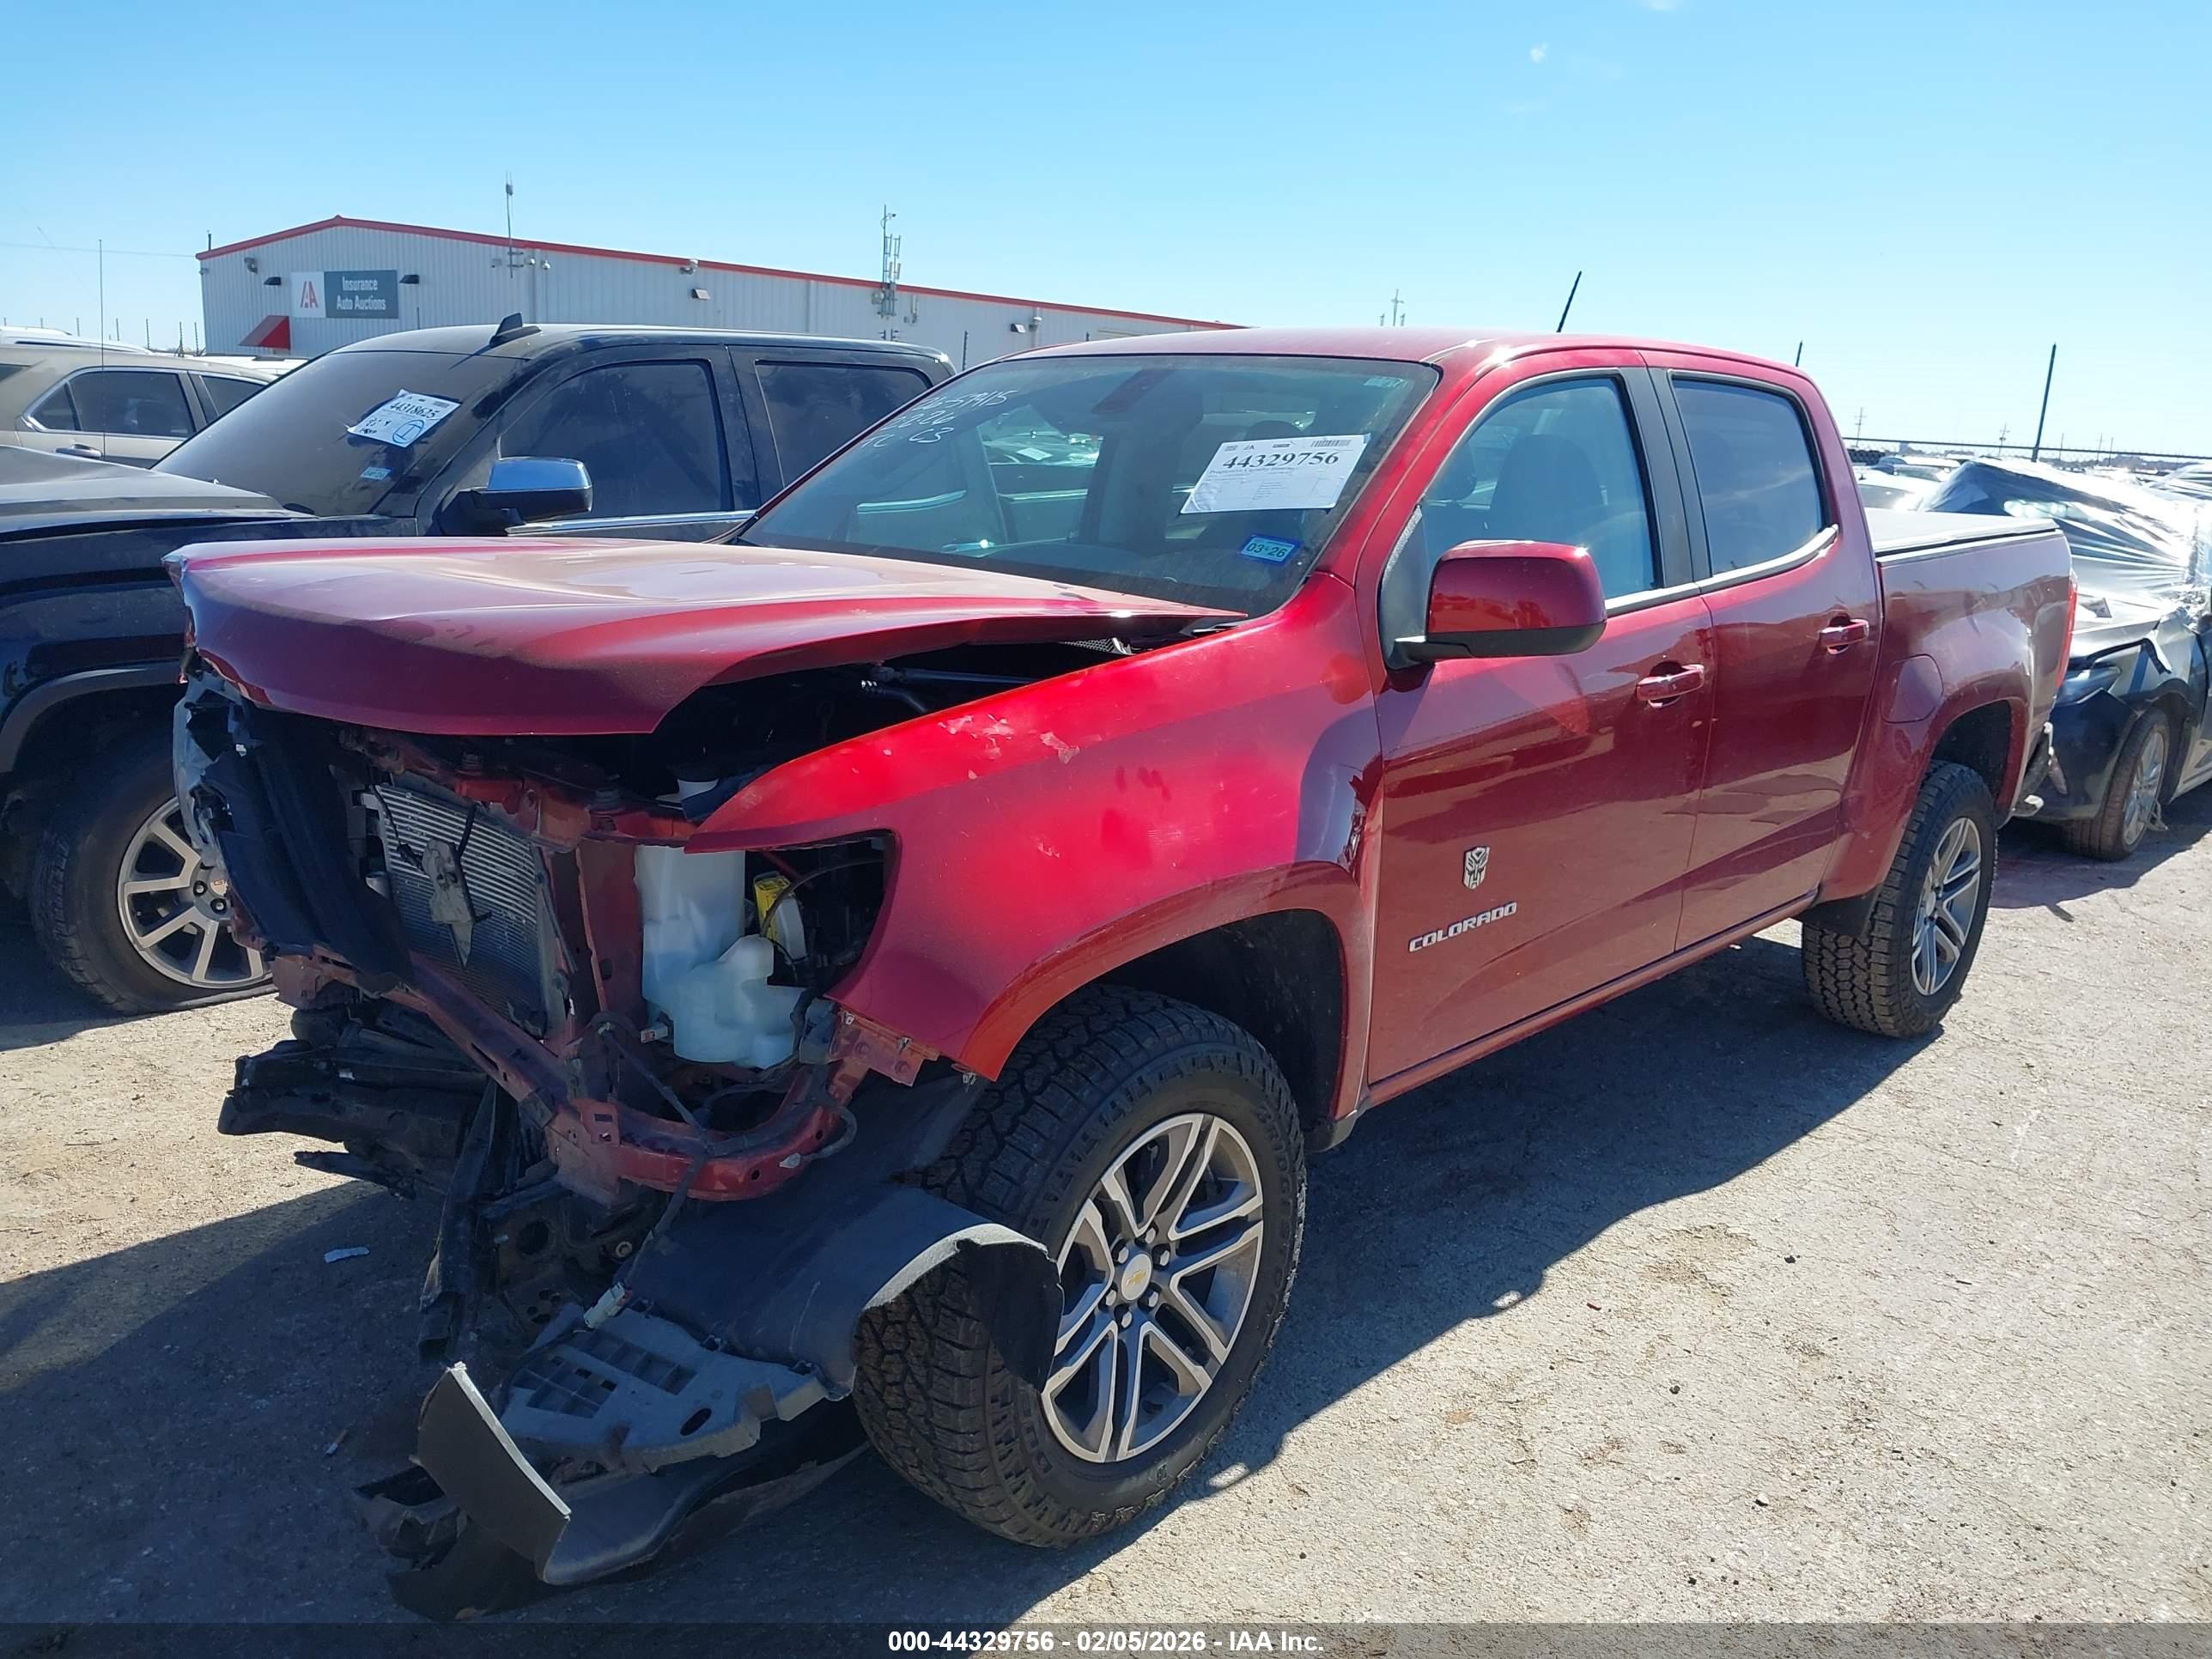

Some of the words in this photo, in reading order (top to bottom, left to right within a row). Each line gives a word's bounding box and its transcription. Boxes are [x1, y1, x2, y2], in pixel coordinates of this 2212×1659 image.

[342, 276, 378, 291] Insurance
[336, 295, 353, 310] Auto
[355, 295, 386, 310] Auctions
[1222, 451, 1340, 470] 44329756
[1409, 902, 1517, 953] COLORADO
